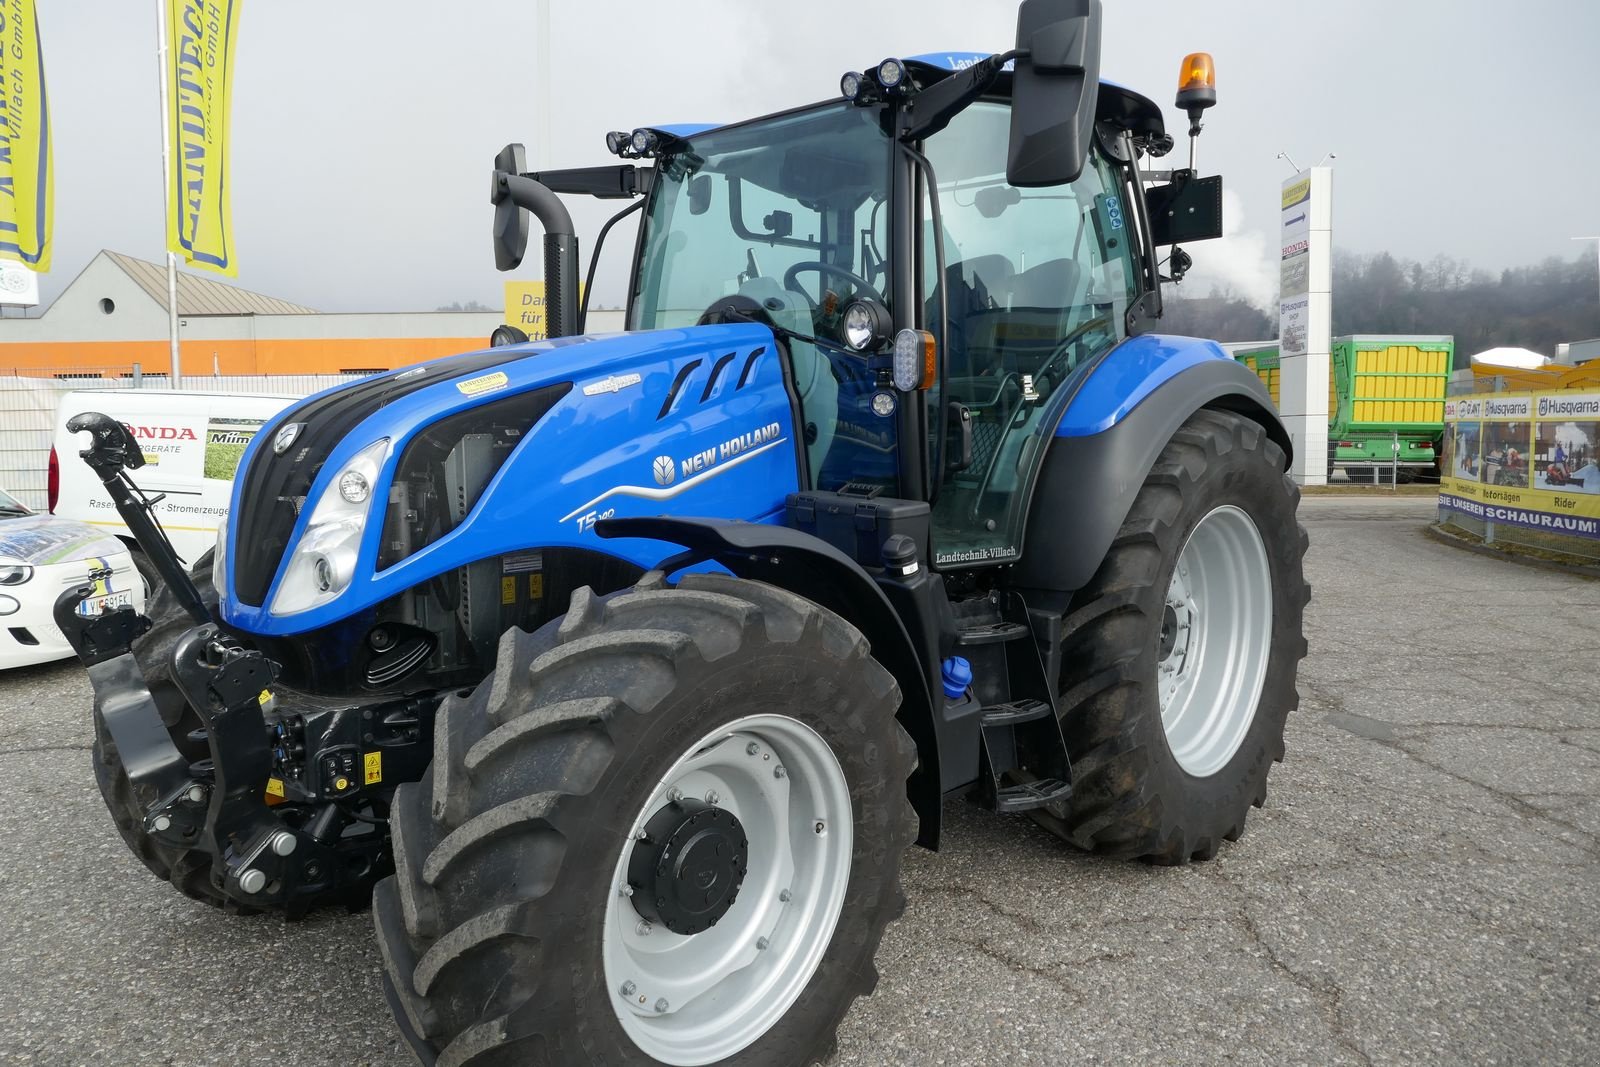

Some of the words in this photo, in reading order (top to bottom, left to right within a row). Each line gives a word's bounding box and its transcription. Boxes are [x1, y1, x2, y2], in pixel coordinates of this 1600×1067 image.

[206, 2, 221, 67] GmbH
[10, 68, 24, 140] Villach
[1282, 240, 1309, 256] HONDA
[521, 311, 542, 324] für
[1489, 401, 1527, 416] Husqvarna
[1548, 399, 1599, 415] Husqvarna
[128, 426, 197, 440] NDA
[211, 432, 251, 444] Miim
[681, 447, 716, 479] NEW
[719, 422, 780, 460] HOLLAND
[1554, 496, 1577, 509] Rider
[1439, 495, 1451, 506] SIE
[1453, 498, 1484, 516] UNSEREN
[1486, 507, 1597, 533] SCHAURAUM!
